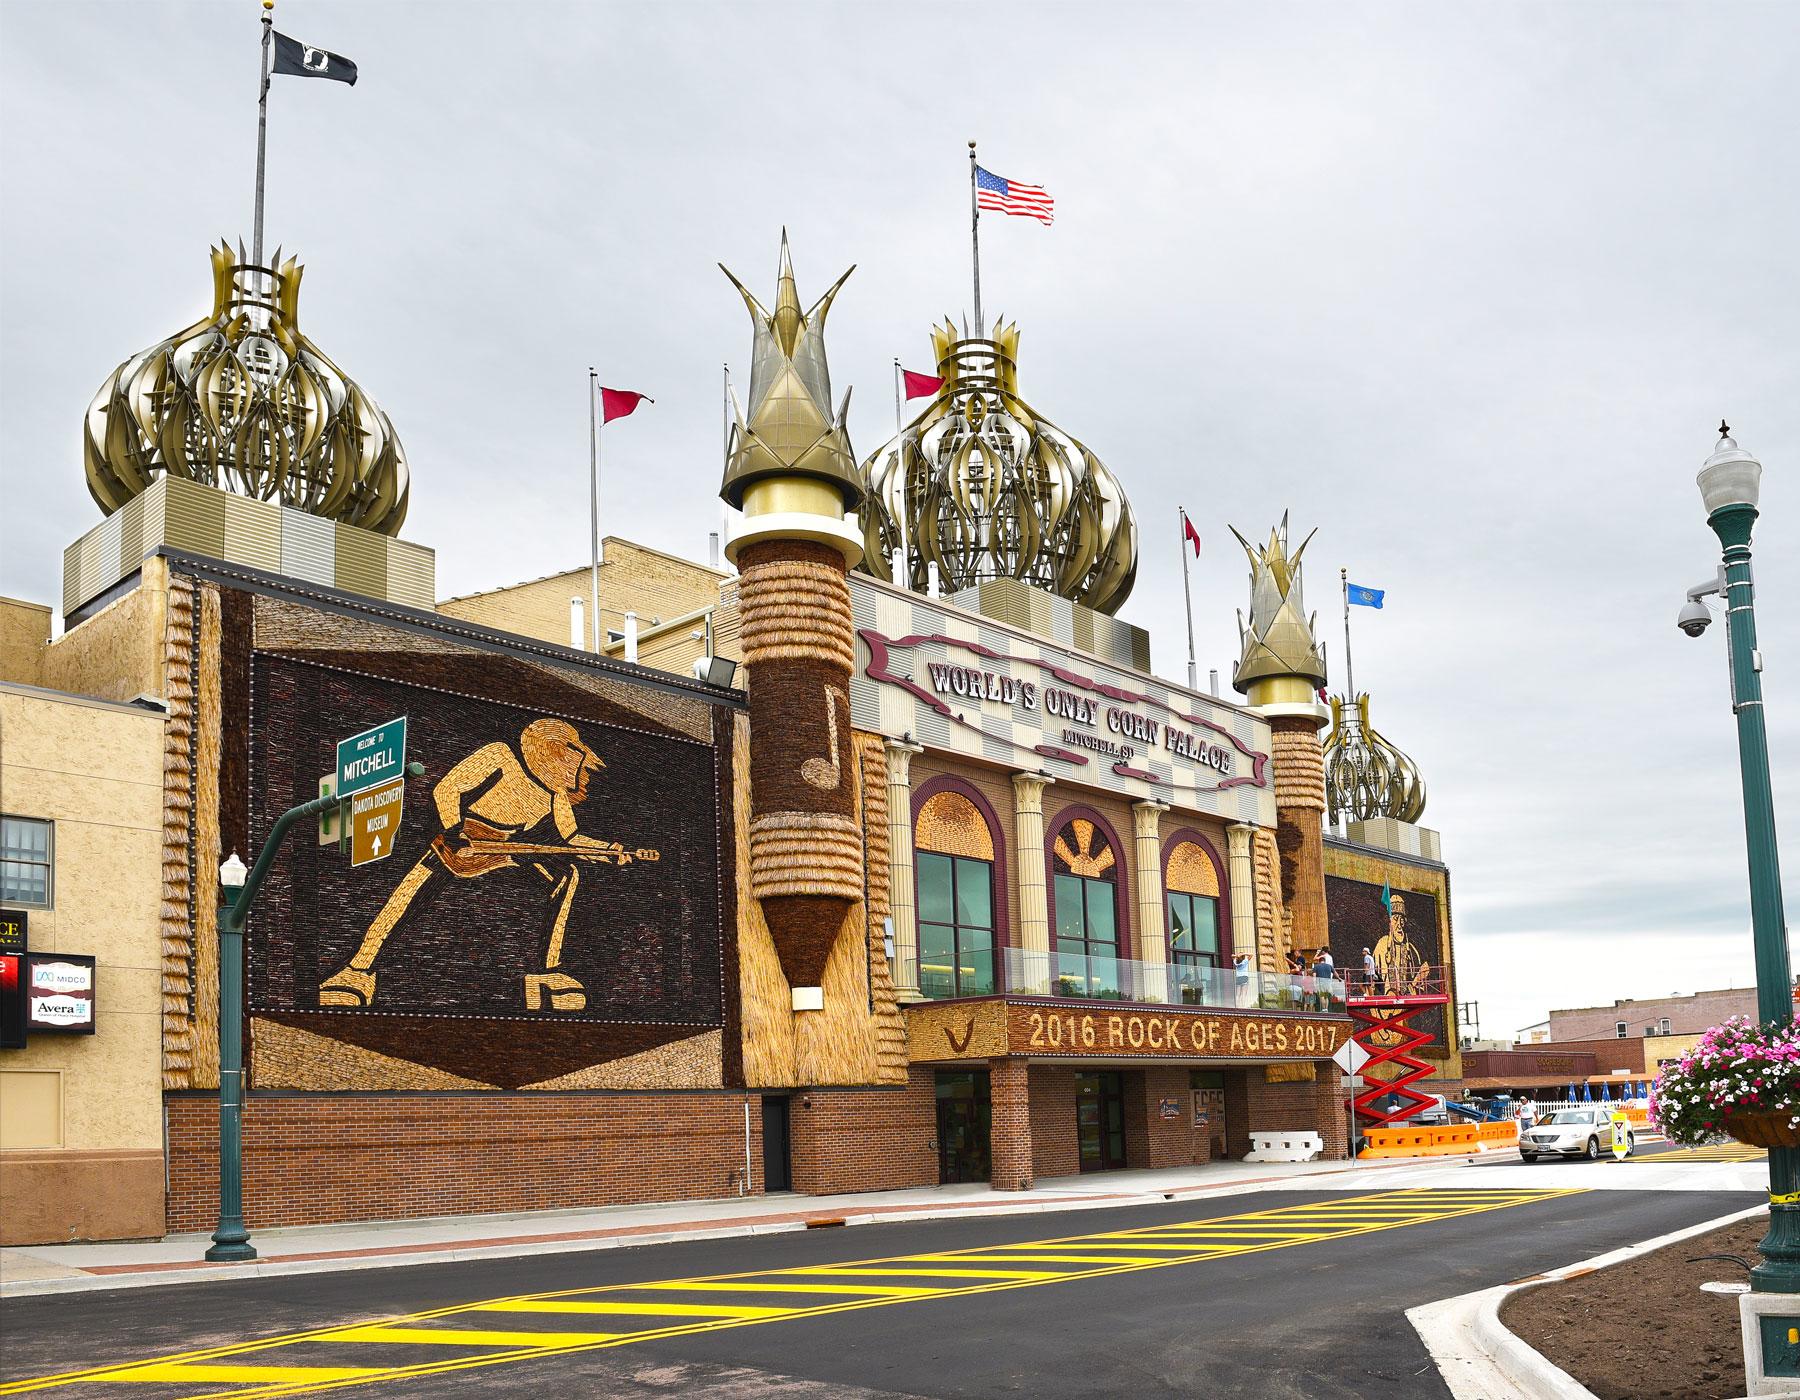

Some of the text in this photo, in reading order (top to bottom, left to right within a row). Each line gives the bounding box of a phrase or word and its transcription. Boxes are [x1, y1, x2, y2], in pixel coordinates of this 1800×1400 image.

[928, 663, 1231, 774] WORLD'S ONLY CORN PALACE
[357, 732, 385, 751] WELCOME TO
[1120, 745, 1135, 758] SD
[344, 748, 396, 782] MITCHELL
[354, 785, 402, 815] DAKOTA DISCOVERY
[367, 812, 388, 833] MUSEUM
[57, 976, 86, 984] MIDCO
[38, 1002, 74, 1013] Avera
[1029, 1013, 1336, 1051] 2016 ROCK OF AGES 2017
